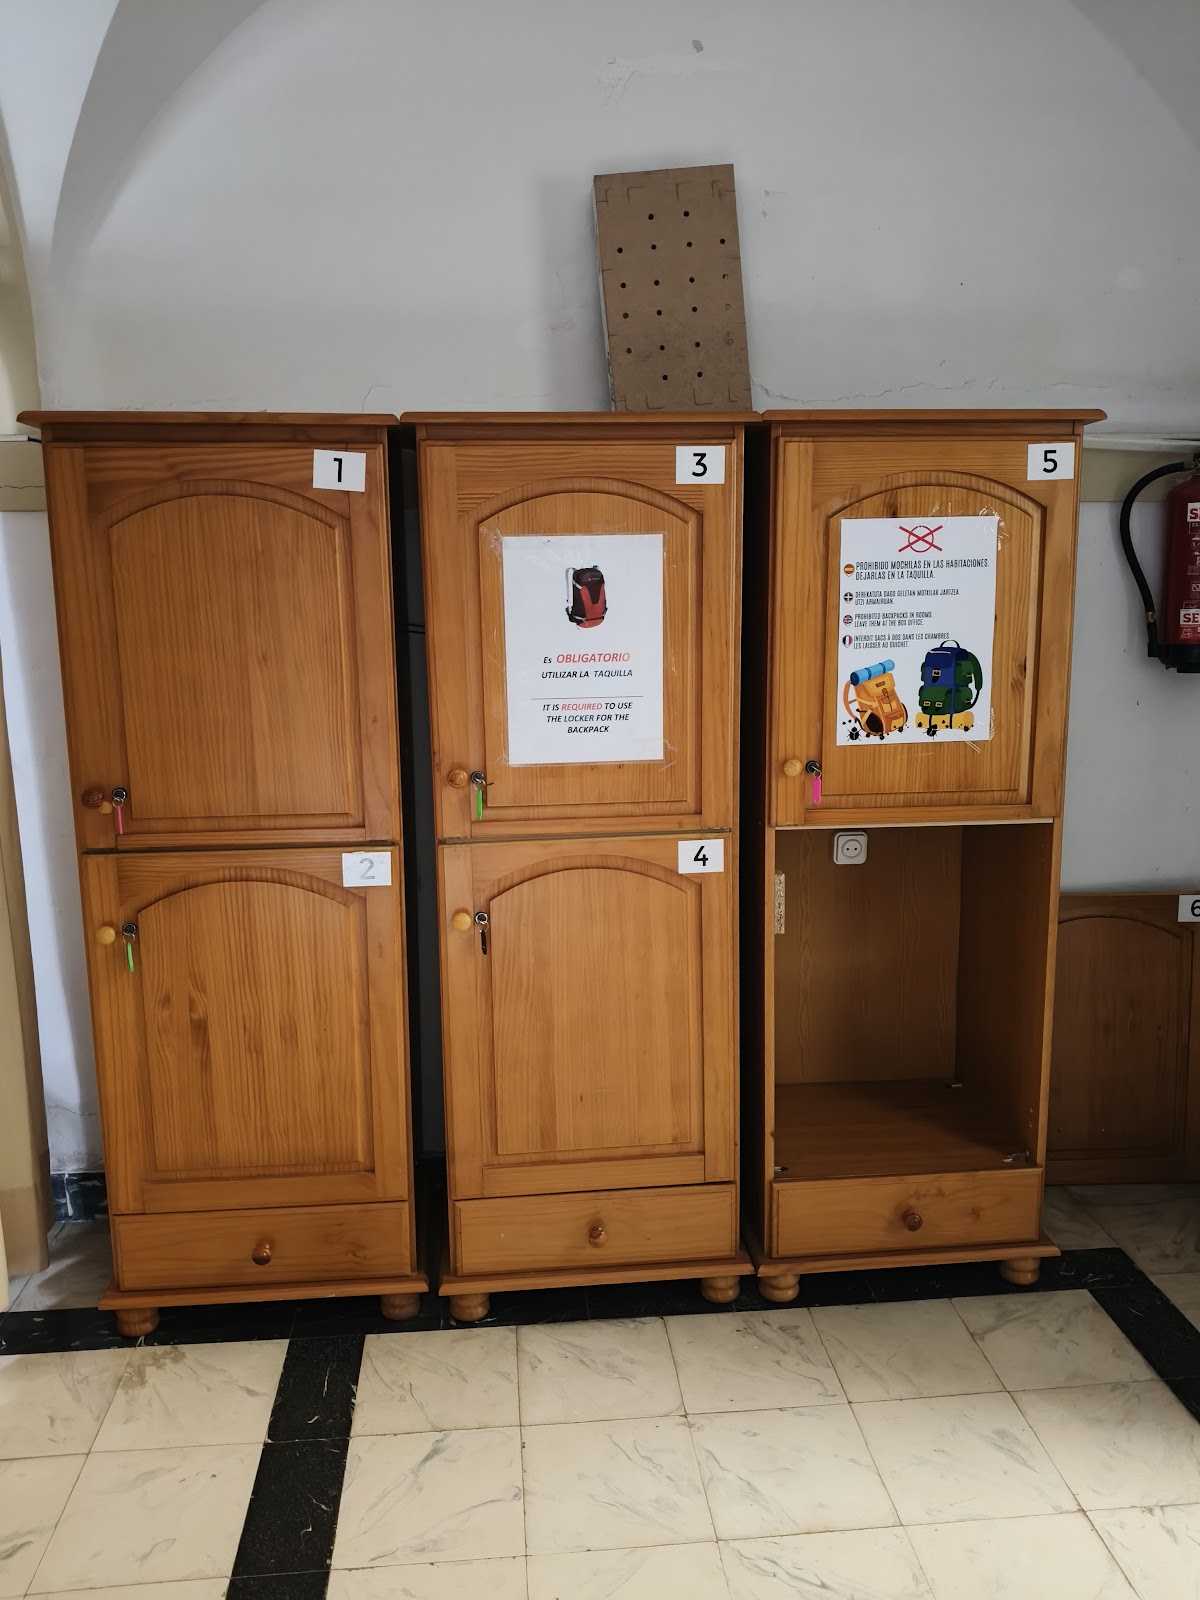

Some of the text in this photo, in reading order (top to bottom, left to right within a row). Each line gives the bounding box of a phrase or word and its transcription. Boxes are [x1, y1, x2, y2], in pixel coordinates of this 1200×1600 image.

[334, 458, 342, 482] 1
[692, 452, 708, 477] 3
[1042, 450, 1058, 473] 5
[1190, 508, 1200, 520] S
[856, 559, 989, 570] PROHIBIDO MOCHILAS EN LAS HABITACIONES.
[856, 570, 935, 580] DEJARLAS EN LA TAQUILLA.
[556, 653, 630, 663] OBLIGATORIO
[694, 846, 708, 866] 4
[360, 858, 376, 880] 2
[1190, 899, 1200, 918] 6
